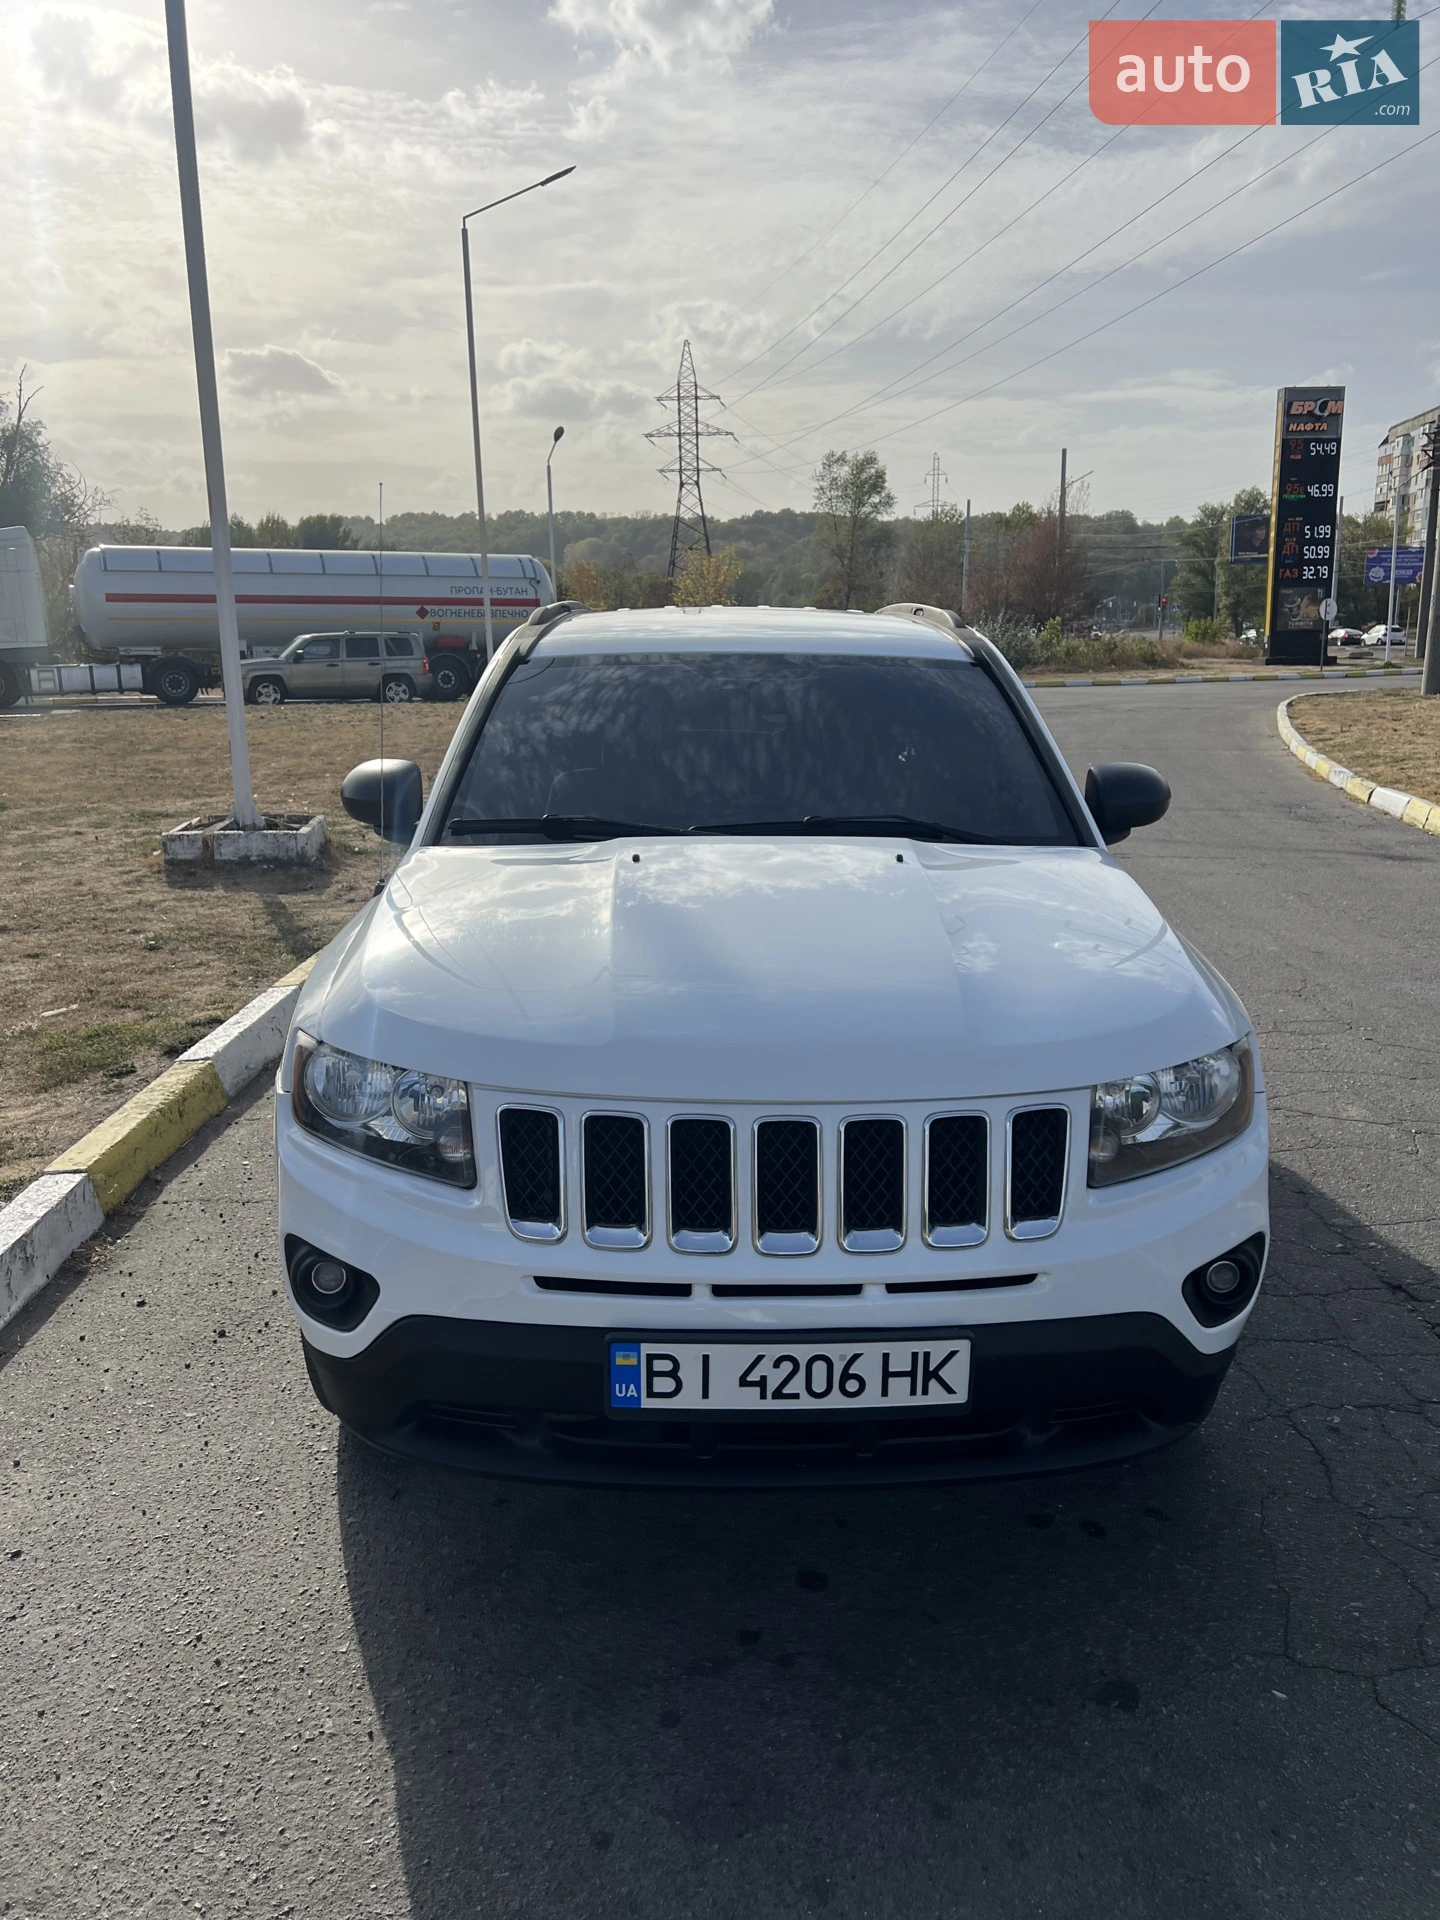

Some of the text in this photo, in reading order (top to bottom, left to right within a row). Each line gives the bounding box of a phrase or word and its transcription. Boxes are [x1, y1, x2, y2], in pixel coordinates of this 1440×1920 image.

[1288, 422, 1328, 432] НАФТА
[1310, 441, 1337, 456] 54.49
[1307, 483, 1335, 498] 46.99
[1283, 522, 1332, 539] ДП 51.99
[1281, 544, 1330, 559] ДП 50.99
[1279, 565, 1329, 580] ГАЗ 32.79
[645, 1349, 960, 1401] BI 4206 HK
[615, 1382, 638, 1398] UA
